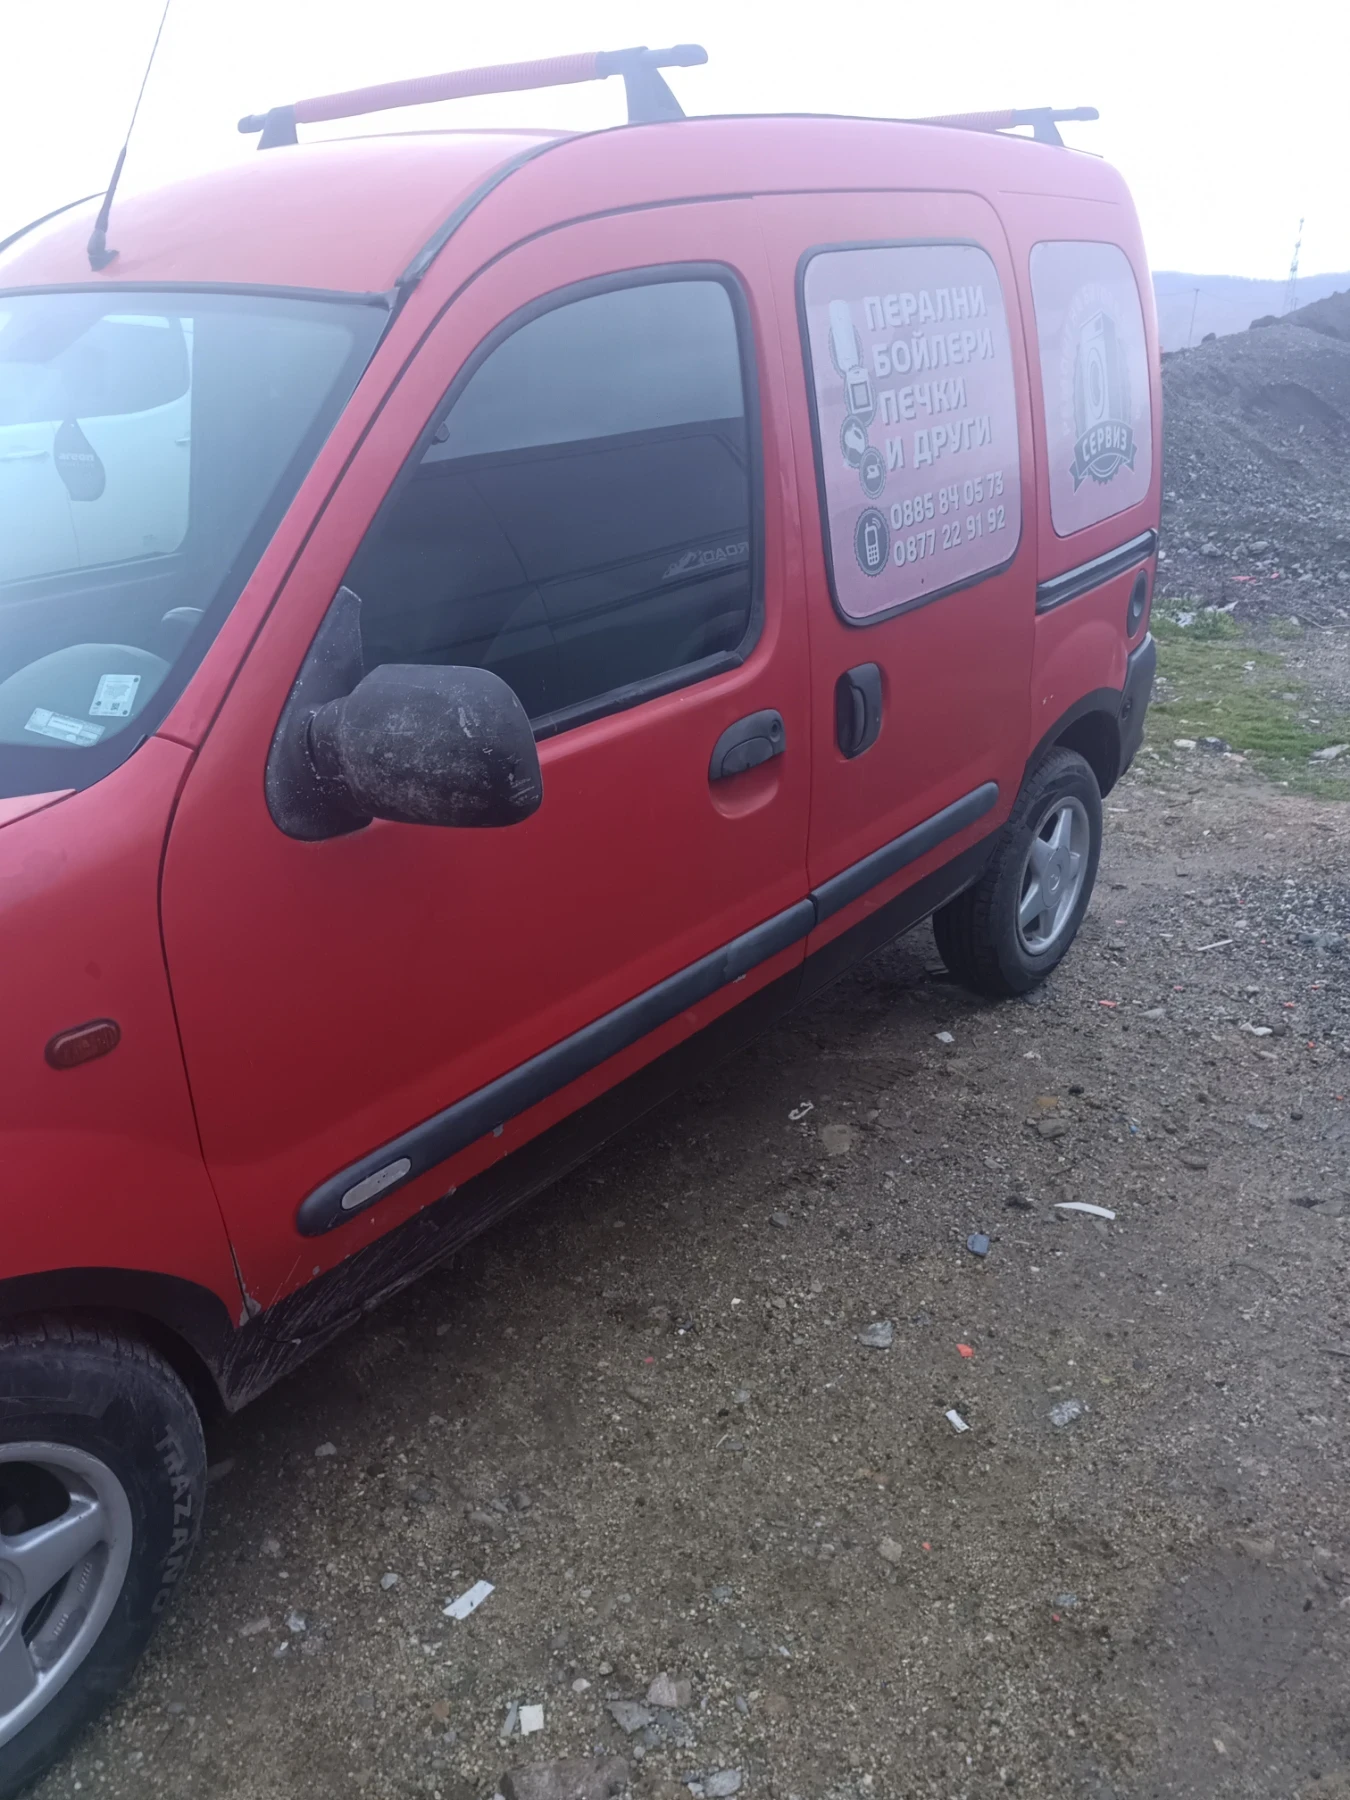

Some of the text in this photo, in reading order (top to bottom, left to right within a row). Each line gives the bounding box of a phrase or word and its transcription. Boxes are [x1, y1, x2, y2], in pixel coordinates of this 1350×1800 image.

[863, 285, 988, 332] ПЕРАЛНИ
[872, 327, 995, 378] БОЙЛЕРИ
[880, 376, 967, 425] ПЕЧКИ
[59, 452, 95, 462] areon
[885, 416, 992, 471] И ДРУГИ
[1082, 425, 1127, 462] СЕРВИЗ
[890, 470, 1003, 530] 0885 84 05 73
[894, 505, 1005, 567] 0877 22 91 92
[152, 1424, 192, 1613] TRAZANO
